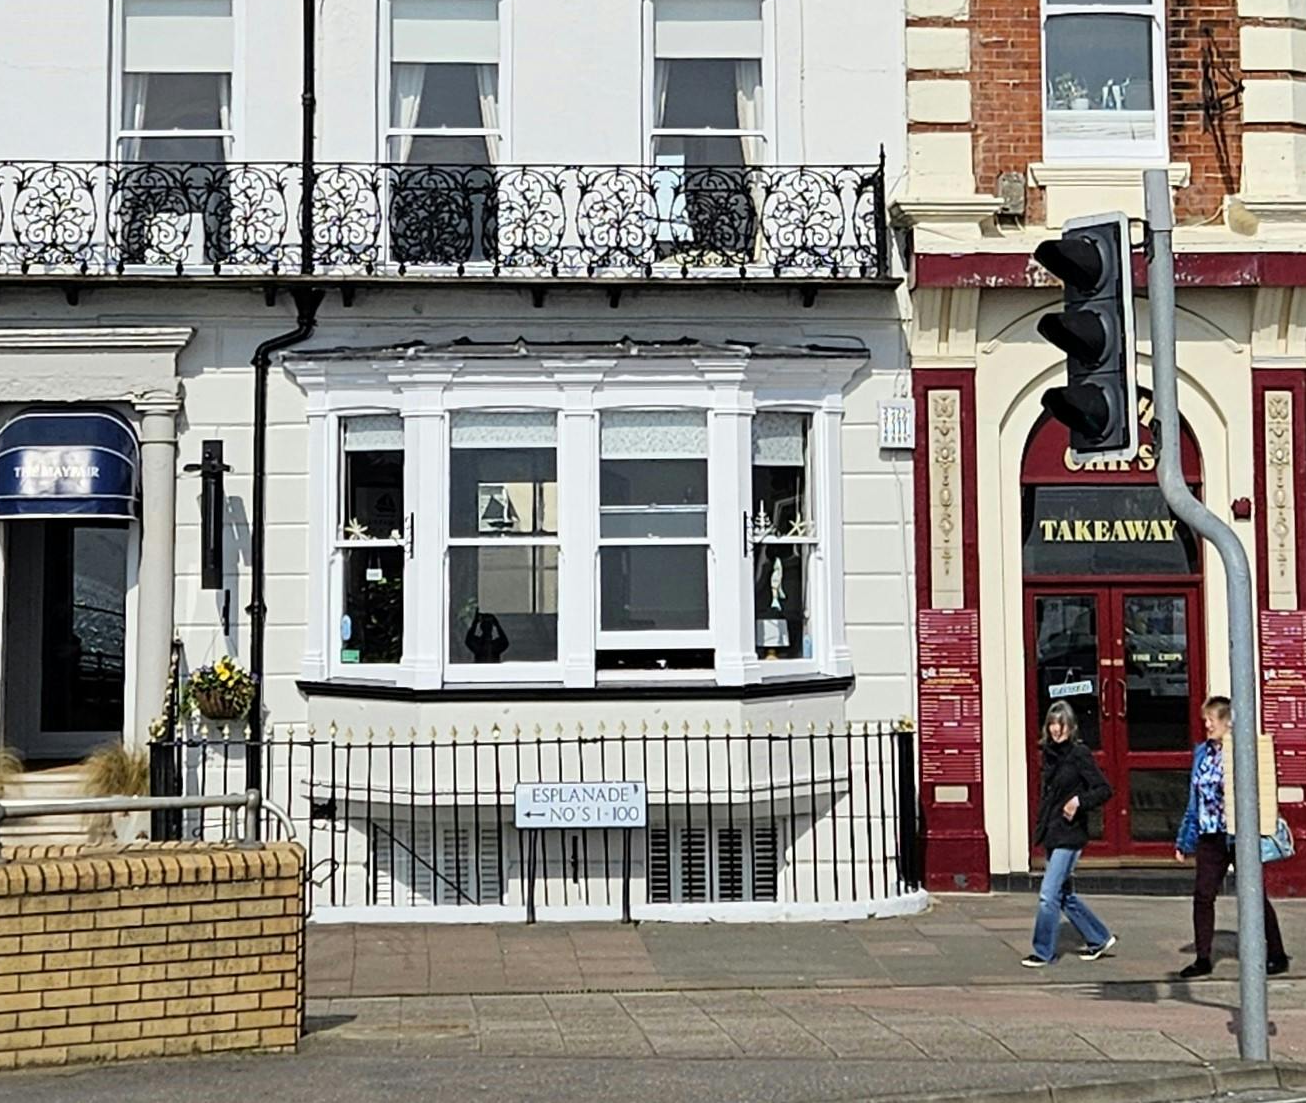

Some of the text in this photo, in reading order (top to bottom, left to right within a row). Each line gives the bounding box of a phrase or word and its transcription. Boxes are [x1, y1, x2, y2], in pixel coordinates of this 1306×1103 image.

[1039, 520, 1177, 542] TAKEAWAY
[532, 787, 629, 803] ESPLANADE
[550, 806, 590, 822] NO'S
